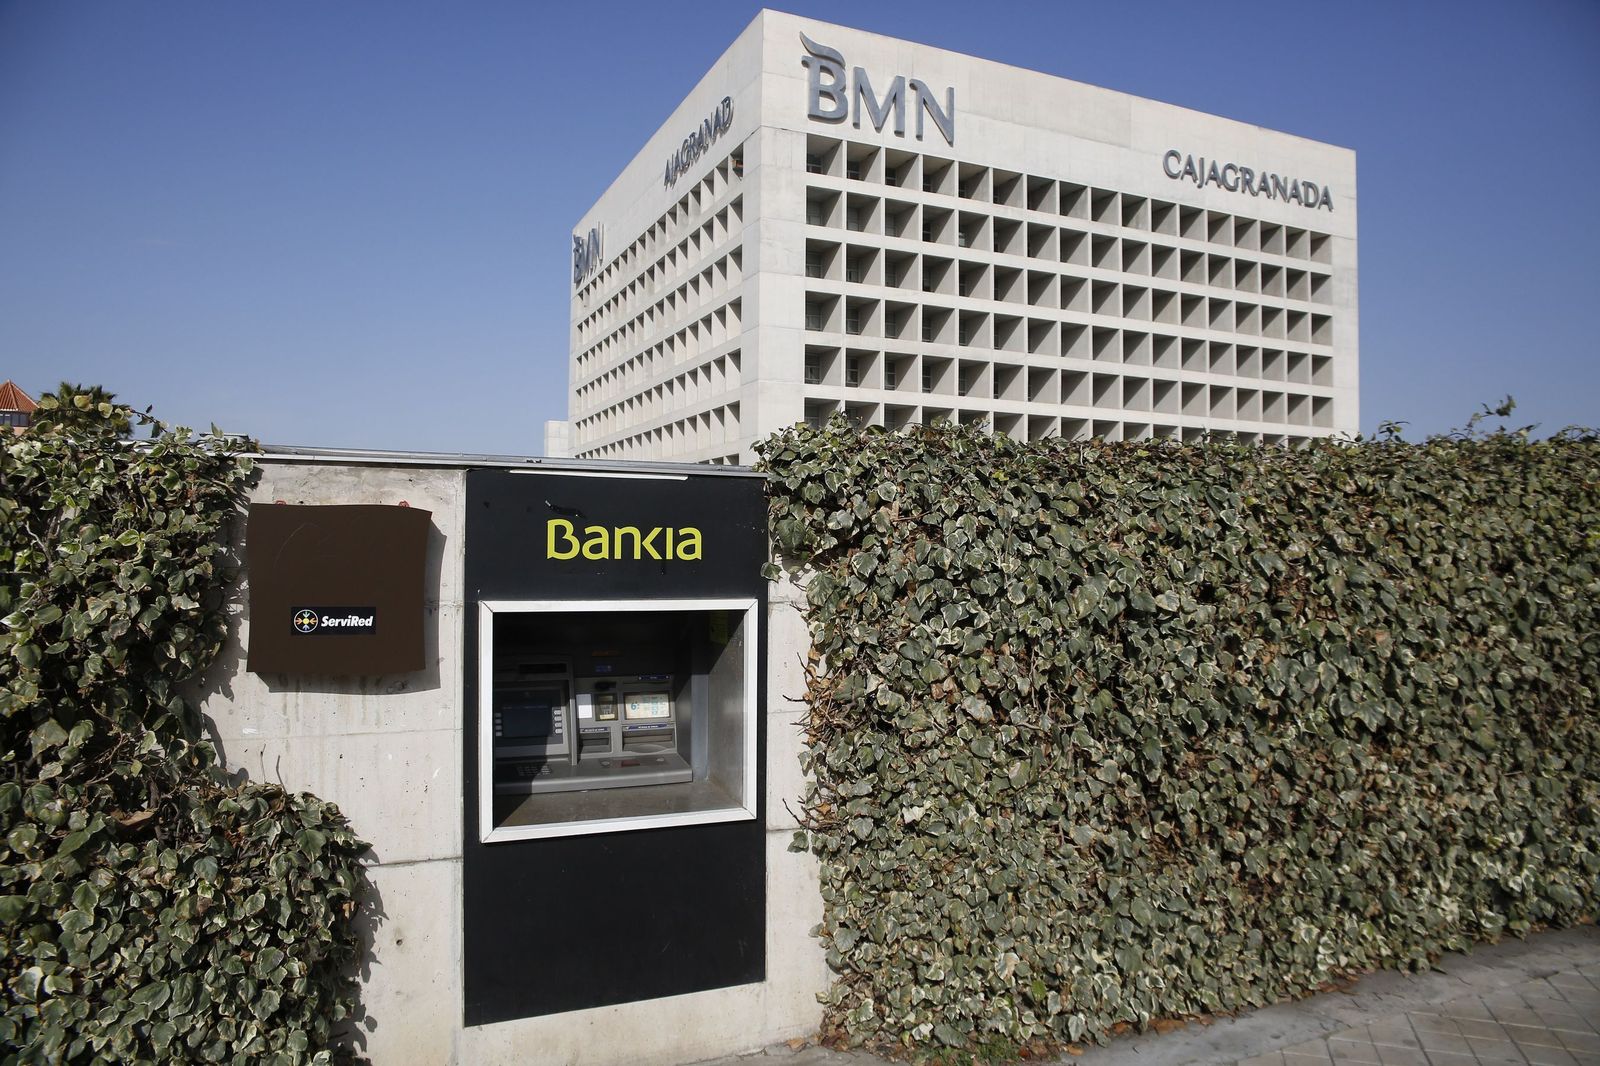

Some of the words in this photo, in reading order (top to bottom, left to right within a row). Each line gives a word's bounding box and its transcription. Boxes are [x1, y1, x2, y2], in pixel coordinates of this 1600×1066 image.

[799, 31, 955, 147] BMN
[1162, 149, 1334, 212] CAJAGRANADA
[546, 518, 702, 560] Bankia
[321, 615, 374, 627] ServiRed
